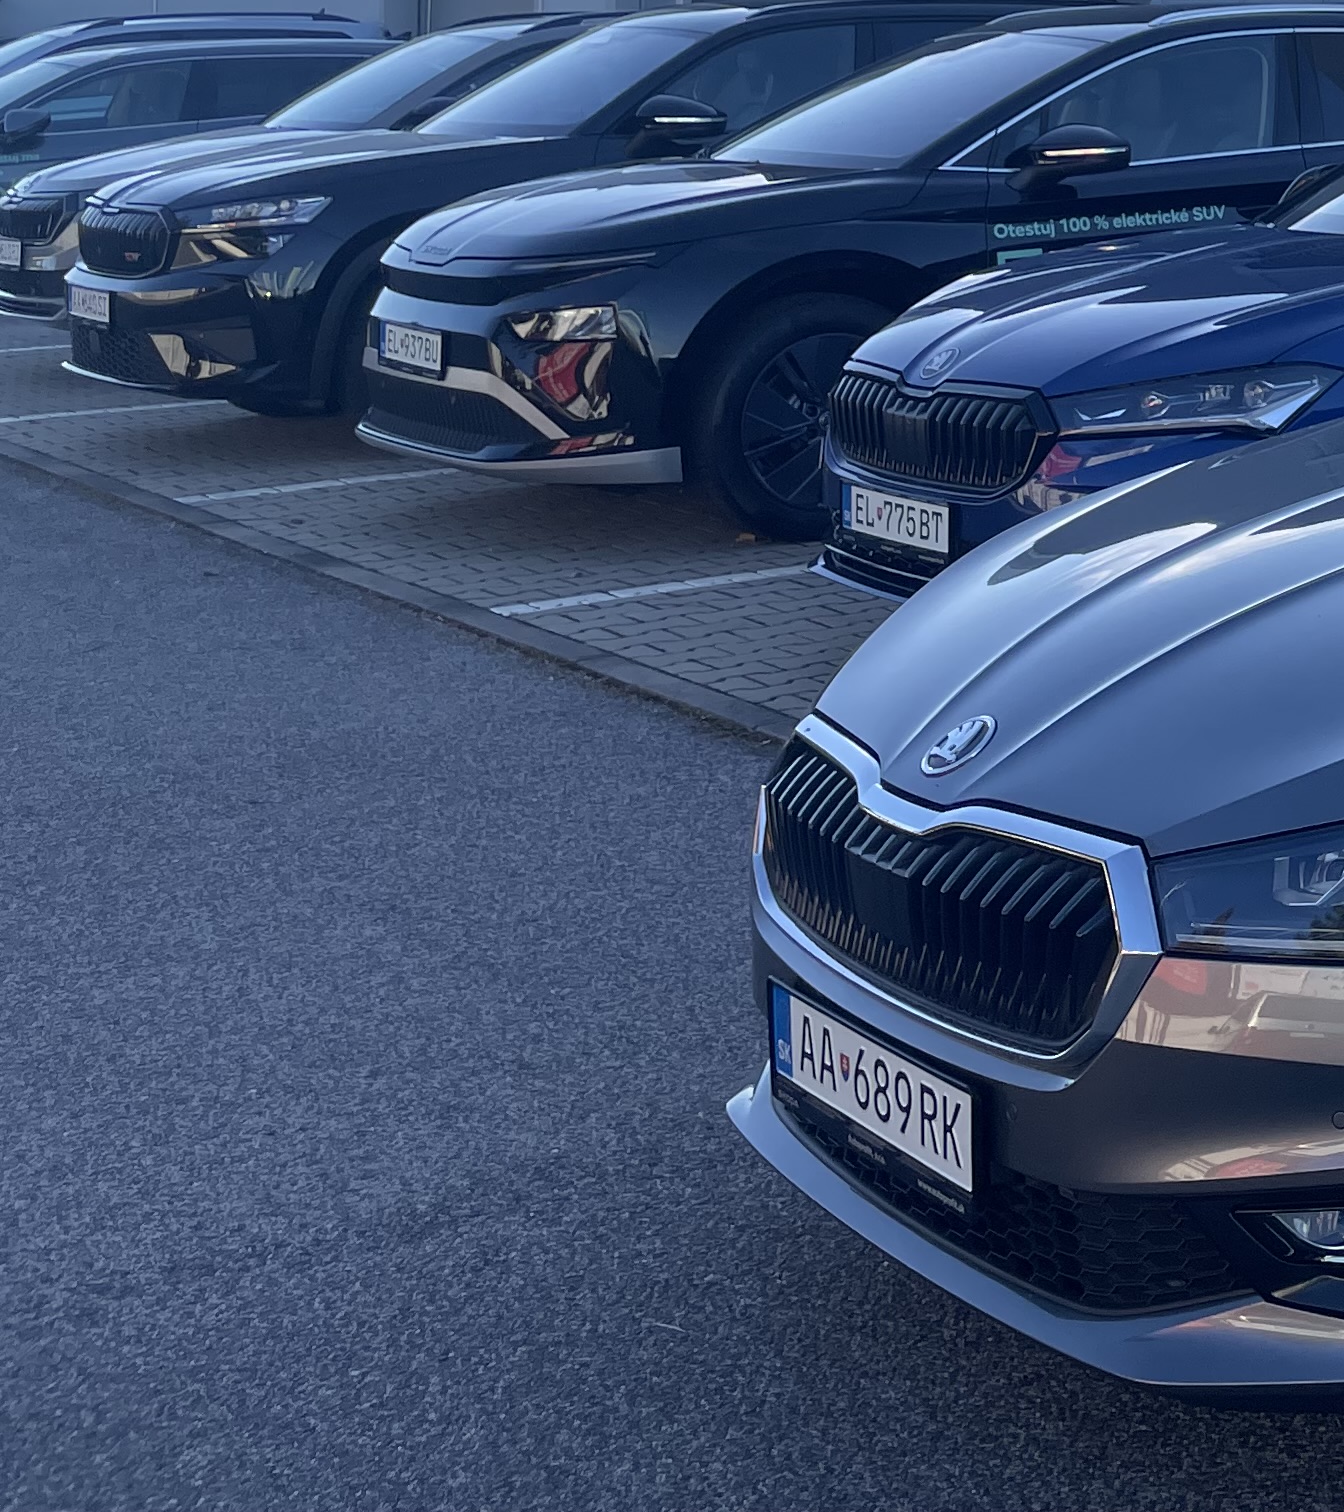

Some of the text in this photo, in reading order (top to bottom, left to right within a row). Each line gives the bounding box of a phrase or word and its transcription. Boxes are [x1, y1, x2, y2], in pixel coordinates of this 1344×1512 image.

[993, 205, 1225, 238] Otestuj 100 % elektrické SUV
[855, 493, 943, 544] EL 775BT
[777, 1038, 791, 1065] SK
[800, 1014, 963, 1169] AA 689RK
